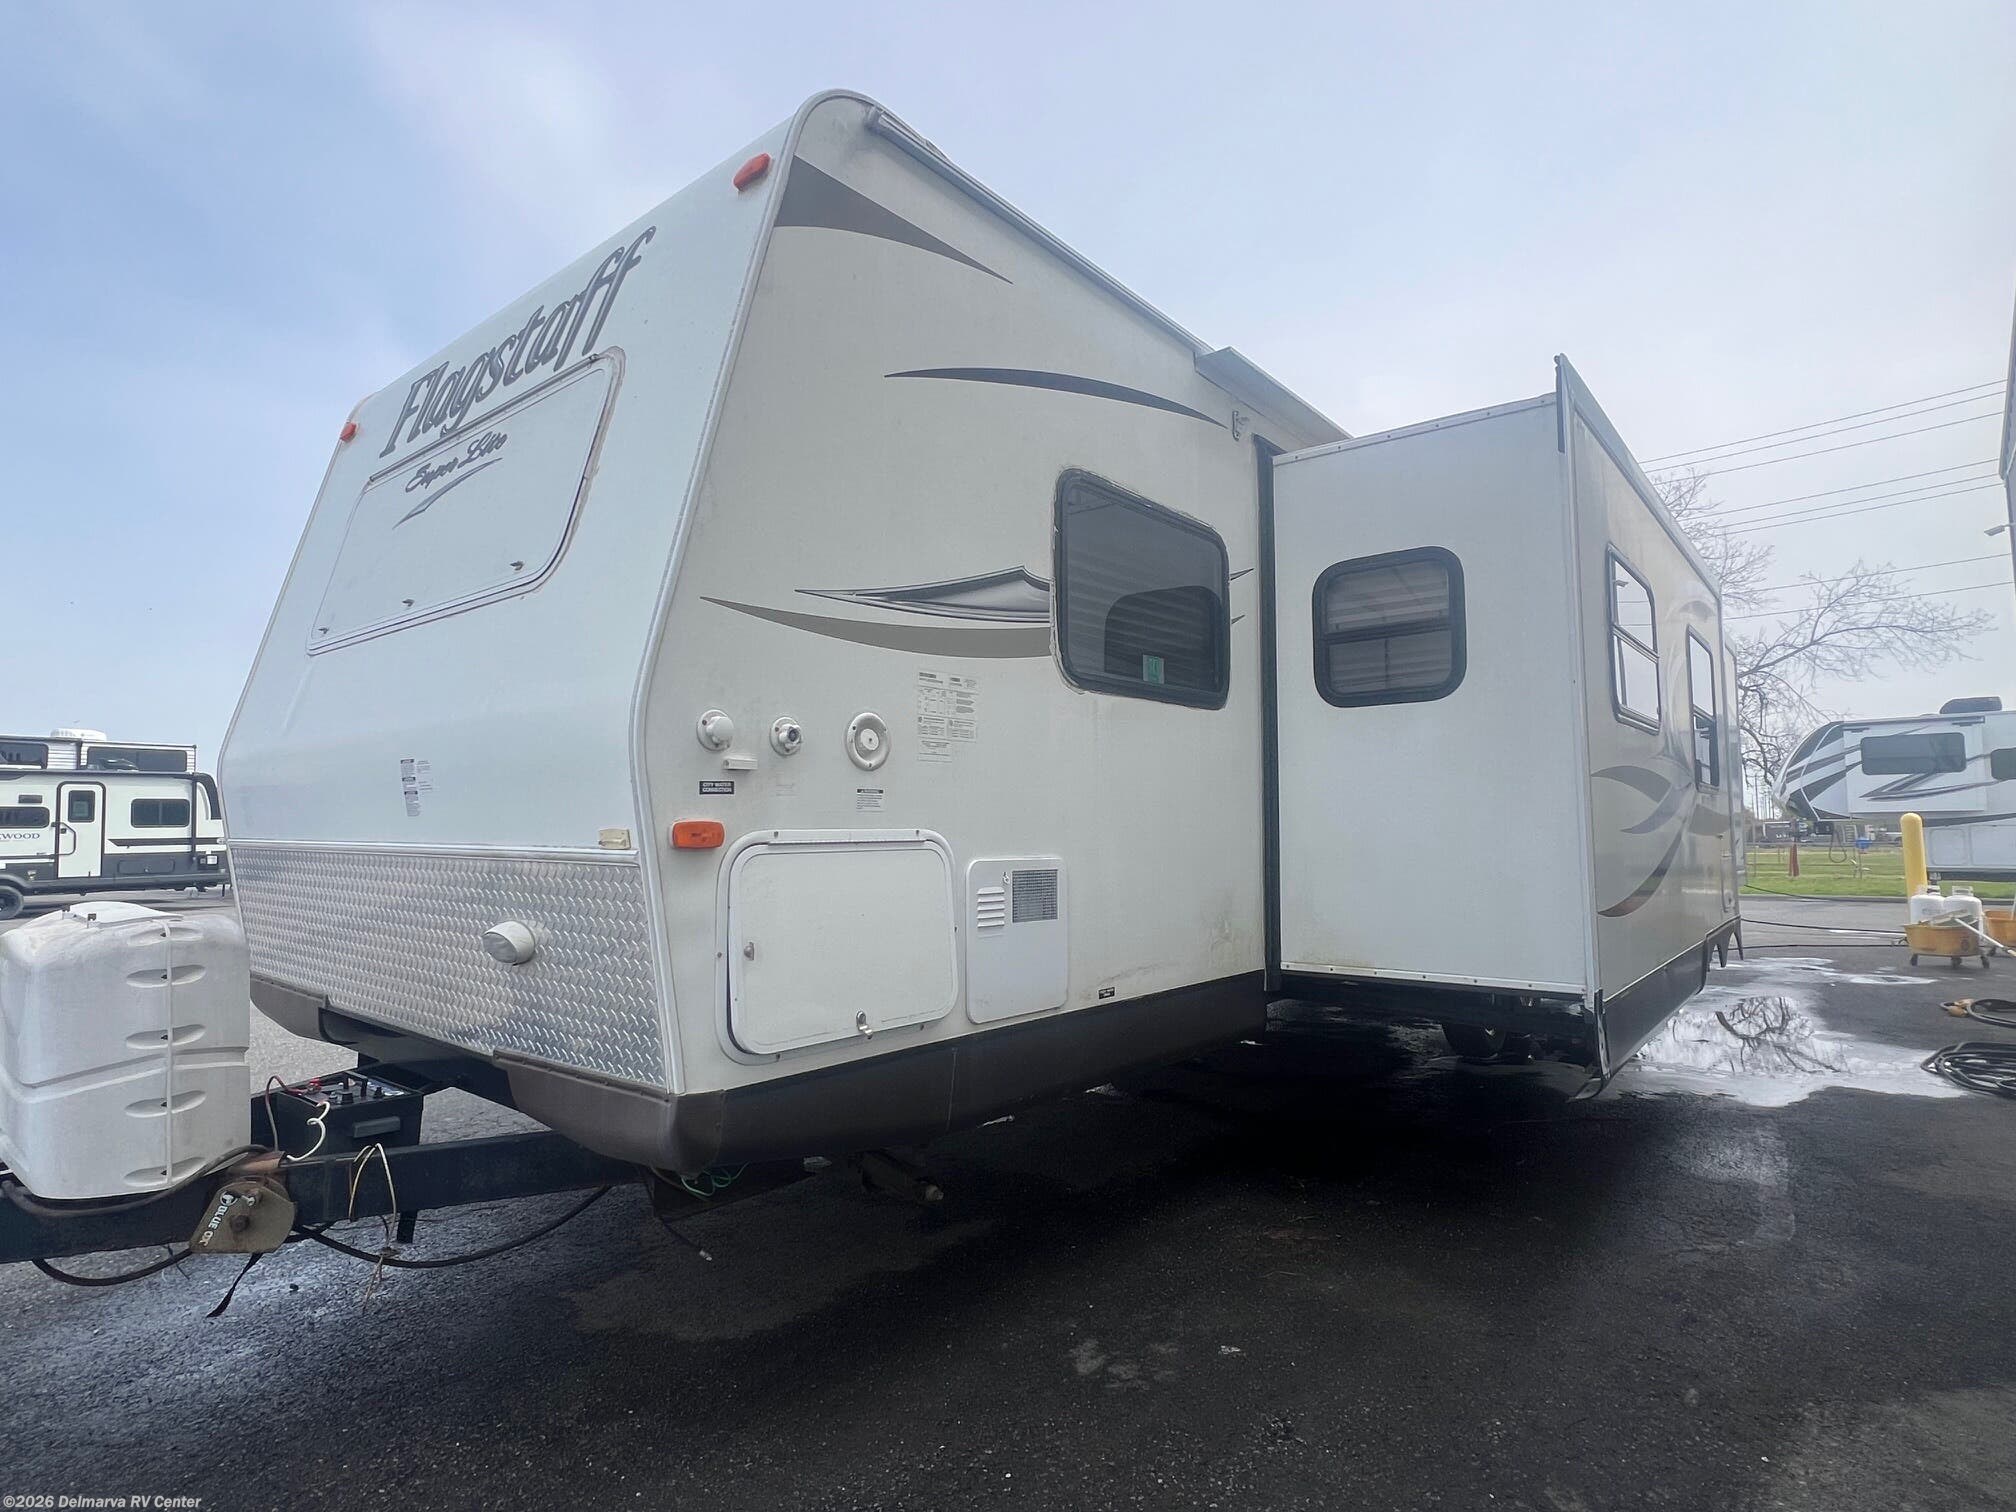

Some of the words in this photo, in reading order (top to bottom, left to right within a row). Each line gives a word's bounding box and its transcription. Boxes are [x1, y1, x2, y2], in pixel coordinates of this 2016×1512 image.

[379, 226, 656, 458] Flagstaff
[405, 458, 459, 492] Super
[457, 432, 508, 469] Lite
